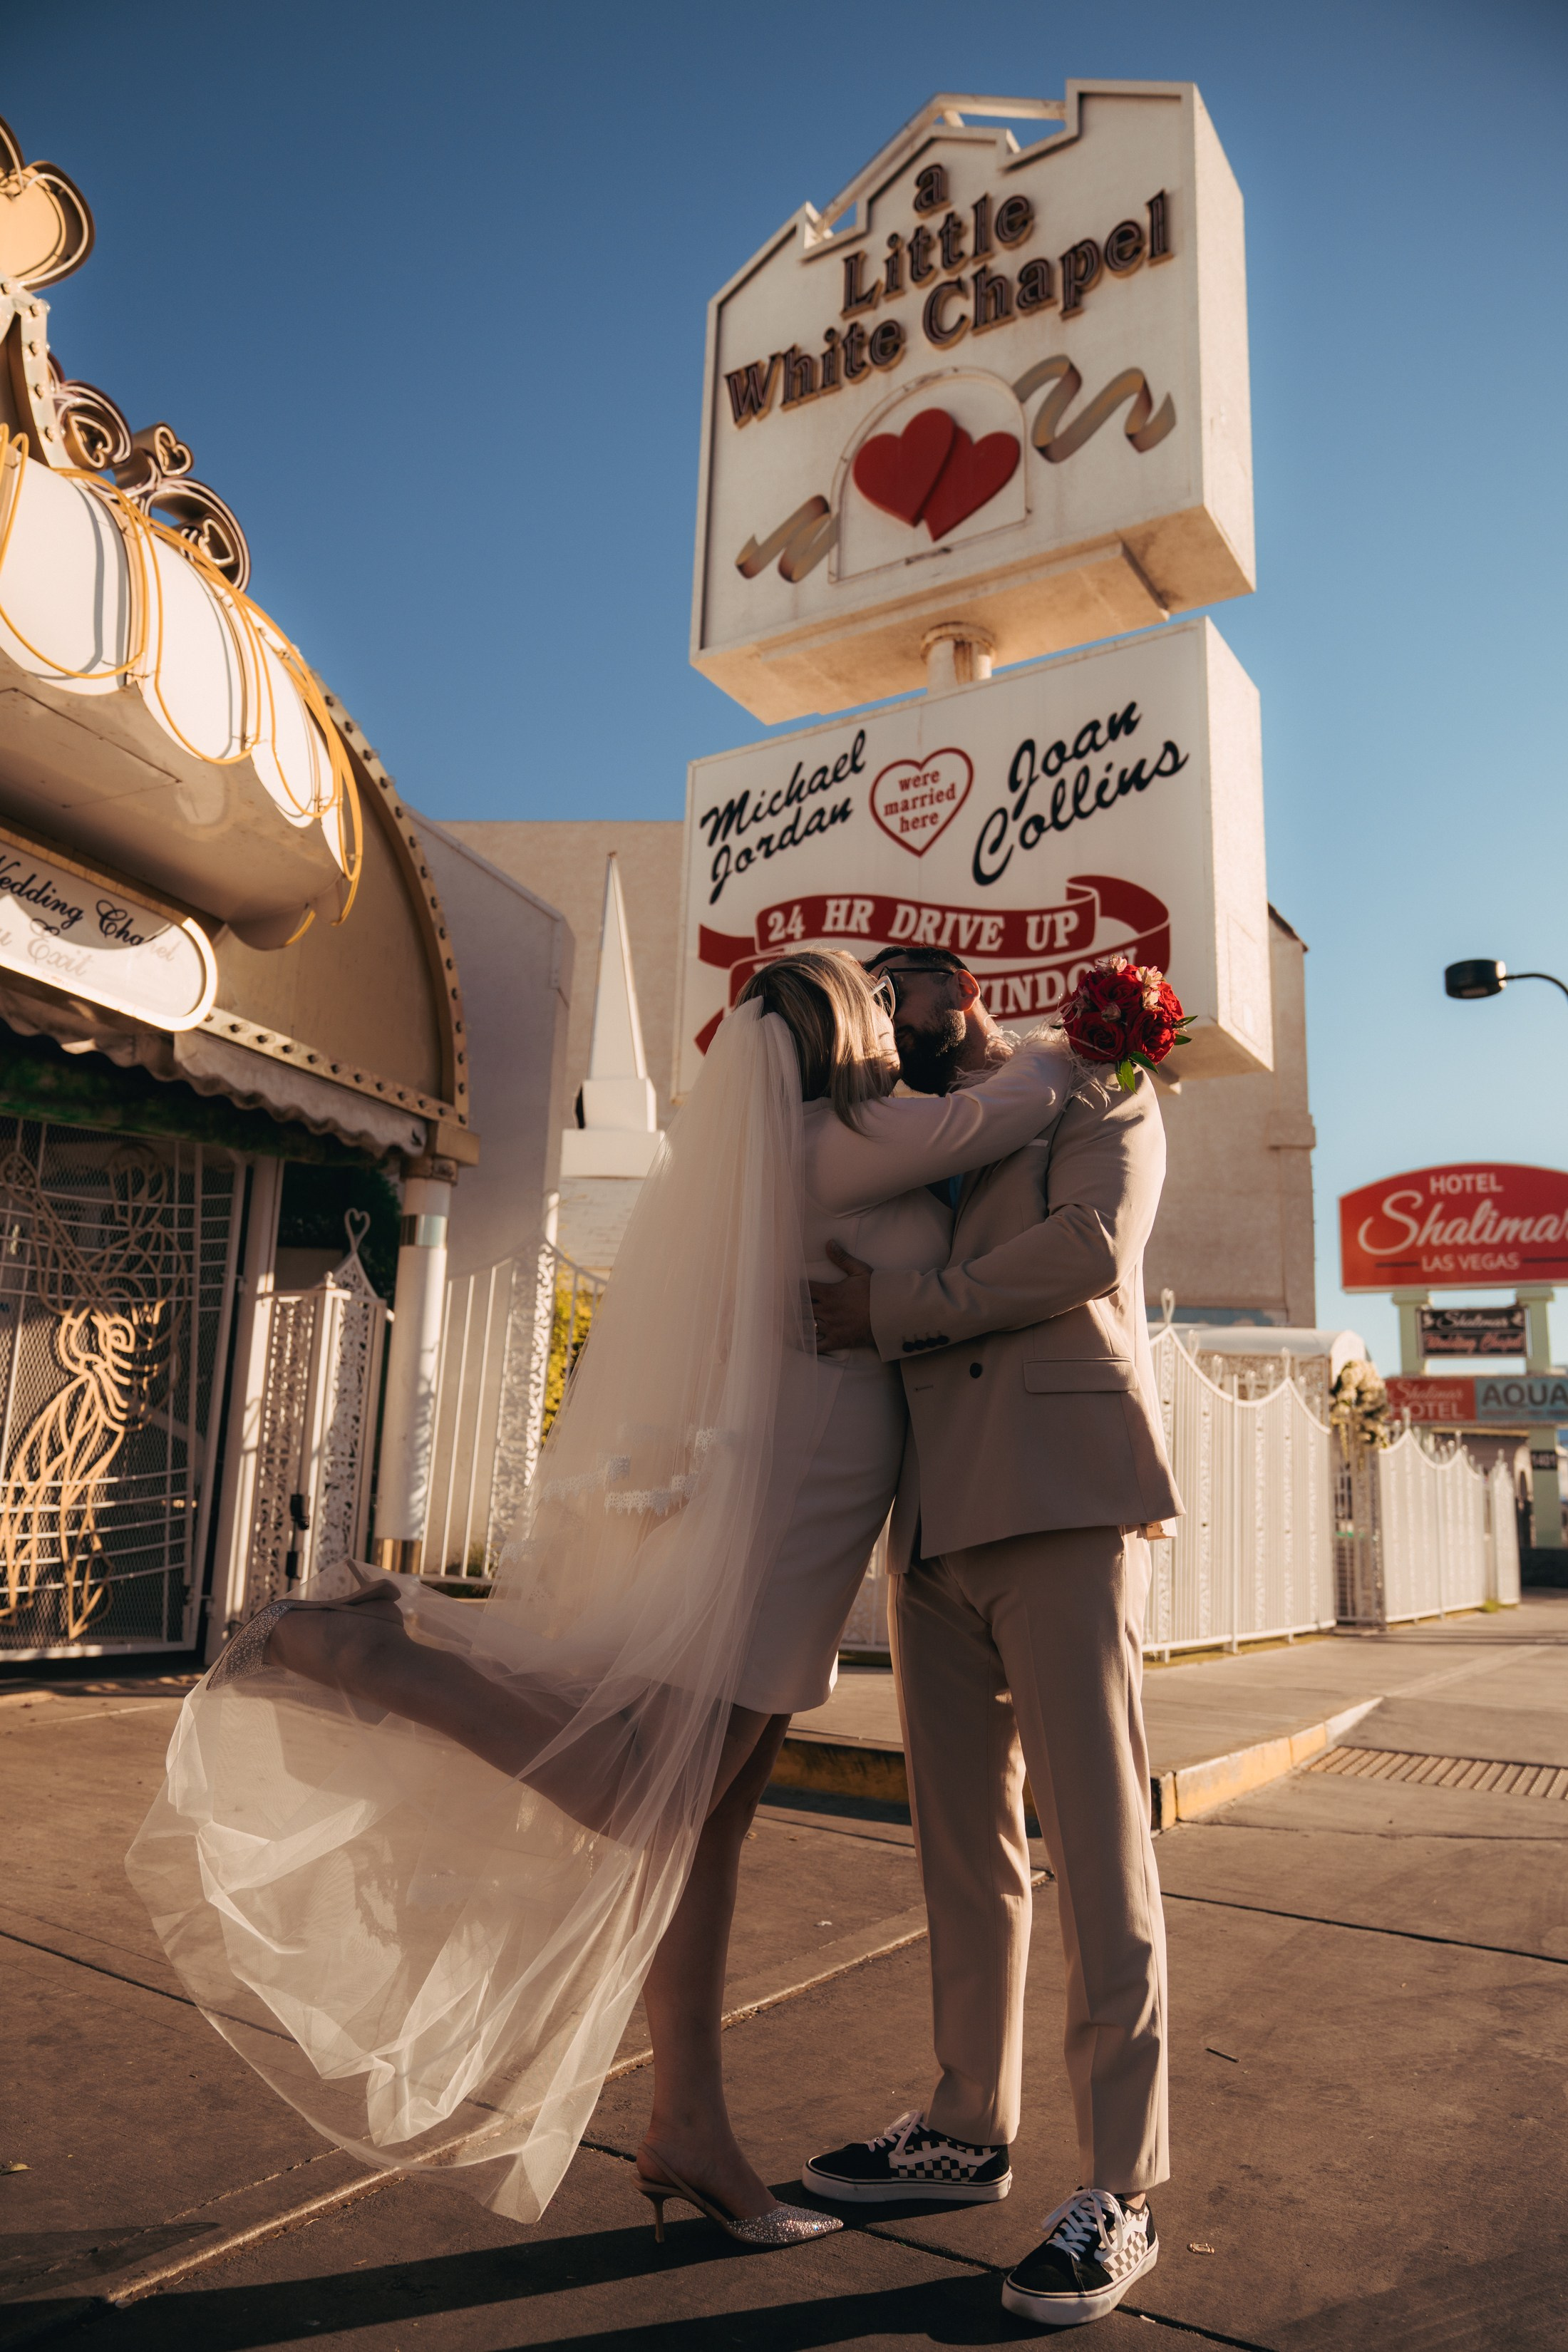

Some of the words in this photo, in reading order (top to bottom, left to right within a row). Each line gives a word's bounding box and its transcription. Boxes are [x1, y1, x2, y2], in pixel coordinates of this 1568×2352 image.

[913, 163, 951, 217] a
[840, 192, 1036, 319] Little
[725, 318, 907, 429] White
[922, 188, 1175, 349] Chapel
[899, 770, 939, 792] were
[1008, 701, 1142, 821] Joan
[699, 729, 866, 847] Michael
[884, 782, 956, 816] married
[899, 813, 939, 833] here
[972, 741, 1190, 886] Collins
[711, 797, 853, 905] Jordan
[768, 905, 805, 942] 24
[821, 898, 875, 934] HR
[888, 904, 1006, 951] DRIVE
[1026, 909, 1079, 951] UP
[27, 918, 94, 976] Exit
[1429, 1173, 1504, 1195] HOTEL
[1422, 1254, 1455, 1272] LAS
[1458, 1252, 1521, 1270] VEGAS
[1436, 1310, 1509, 1331] Shalimar
[1387, 1380, 1463, 1401] Shalimar
[1390, 1400, 1464, 1420] HOTEL
[1482, 1383, 1568, 1408] AQUA
